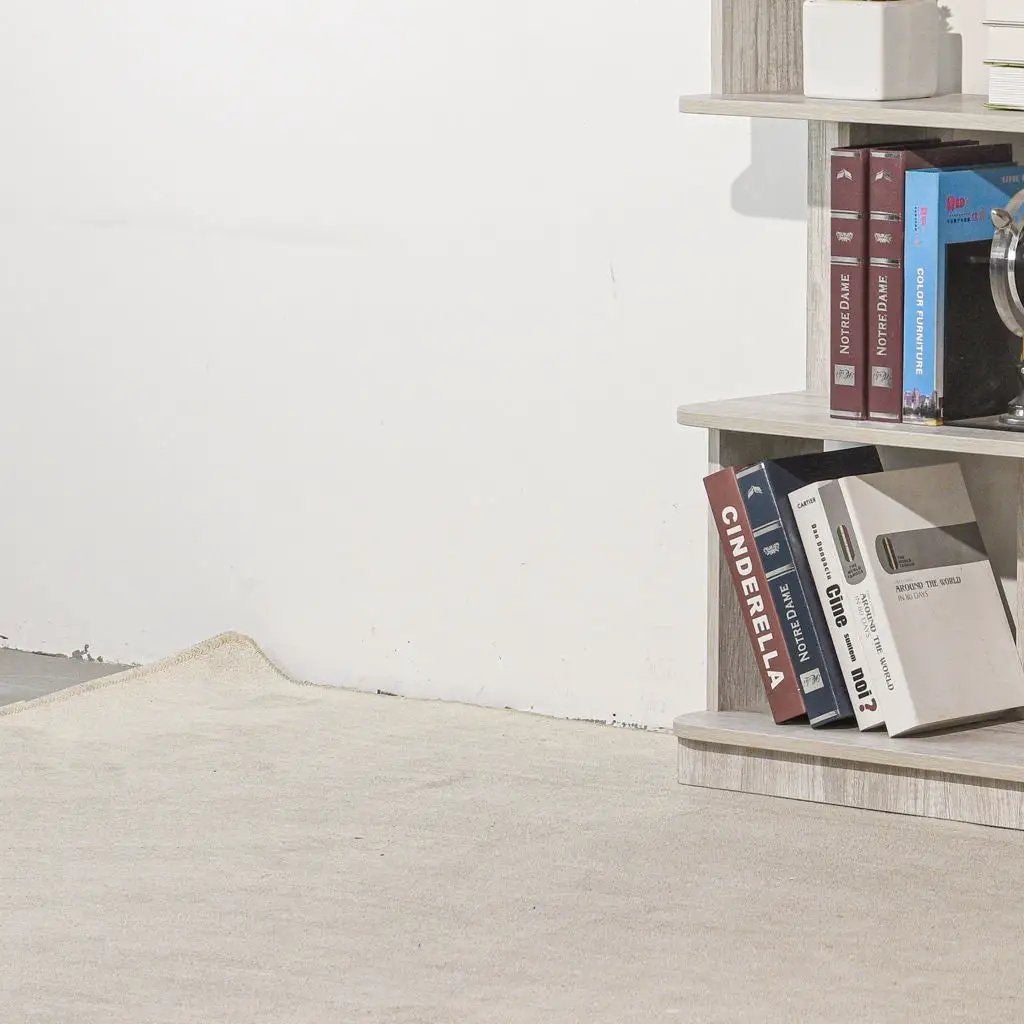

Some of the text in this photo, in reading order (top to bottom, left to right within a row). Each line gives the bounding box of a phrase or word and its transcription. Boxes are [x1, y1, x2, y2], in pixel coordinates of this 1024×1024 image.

[840, 274, 850, 354] NOTRE DAME
[877, 276, 888, 356] NOTRE DAME
[916, 268, 924, 375] COLOR FURNITURE
[797, 497, 816, 510] CARTIER
[722, 506, 785, 690] CINDERELLA
[780, 584, 810, 663] NOTRE DAME
[896, 582, 924, 593] AROUND
[940, 576, 962, 586] WORLD
[914, 590, 929, 599] DAYS
[826, 584, 878, 712] Cine suntem noi?
[860, 593, 894, 691] AROUND THE WORLD
